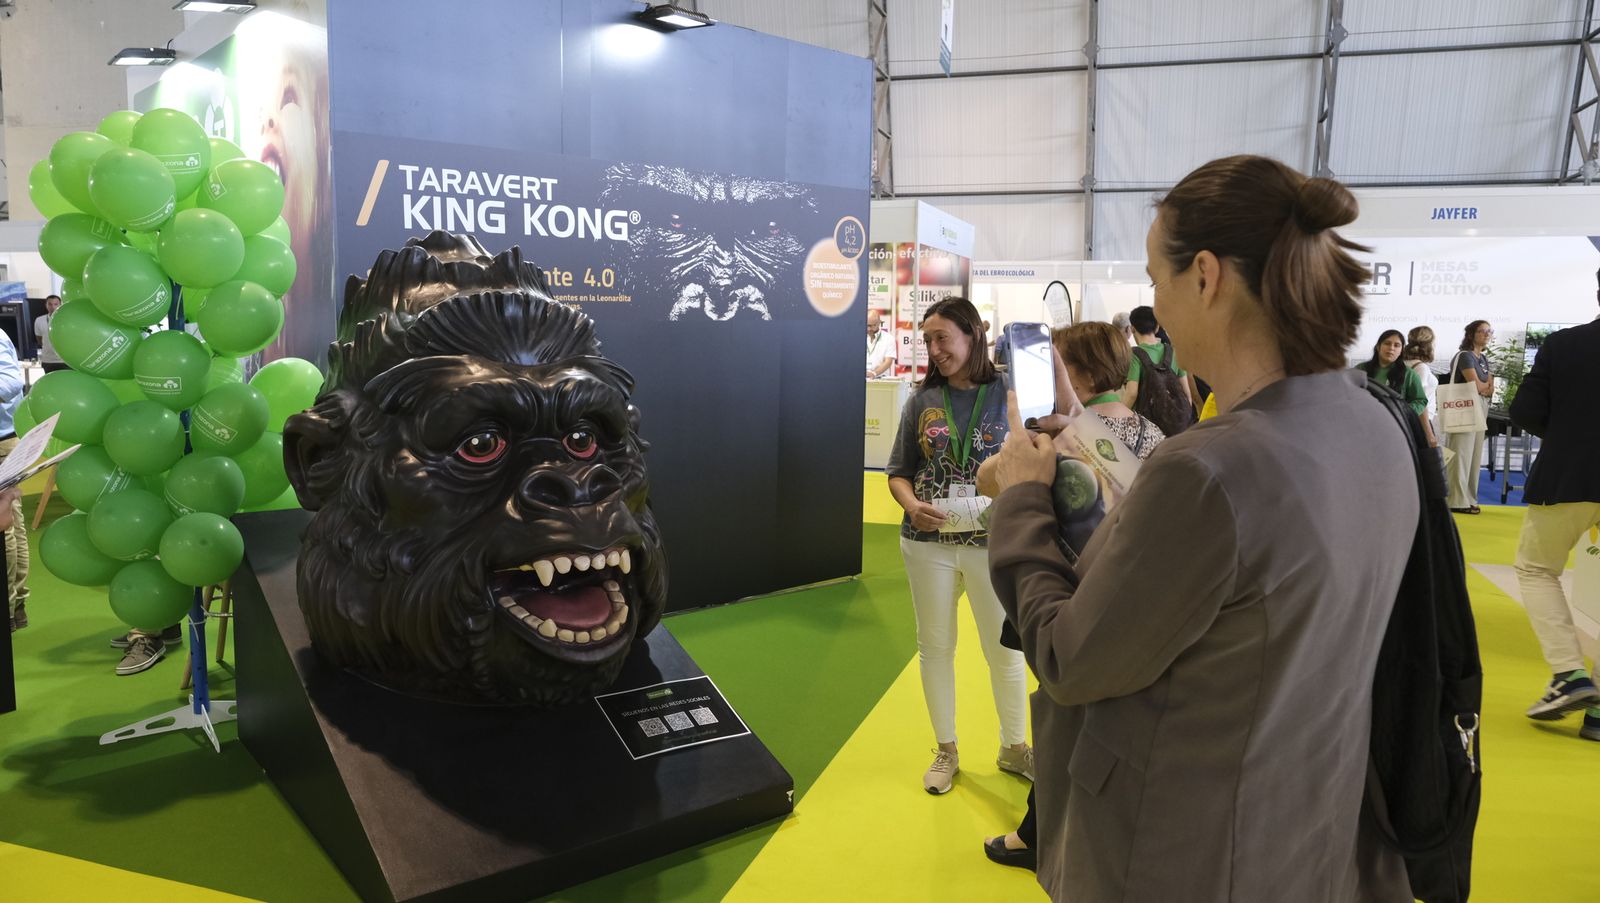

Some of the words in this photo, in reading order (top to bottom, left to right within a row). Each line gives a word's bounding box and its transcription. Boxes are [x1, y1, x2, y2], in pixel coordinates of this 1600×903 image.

[398, 164, 558, 201] TARAVERT
[402, 193, 506, 235] KING
[1431, 207, 1478, 220] JAYFER
[1420, 260, 1480, 273] MESAS
[583, 268, 615, 288] 4.0
[809, 279, 823, 289] SIN
[1420, 272, 1468, 284] PARA
[1419, 284, 1493, 296] CULTIVO
[596, 294, 632, 303] Leonardita
